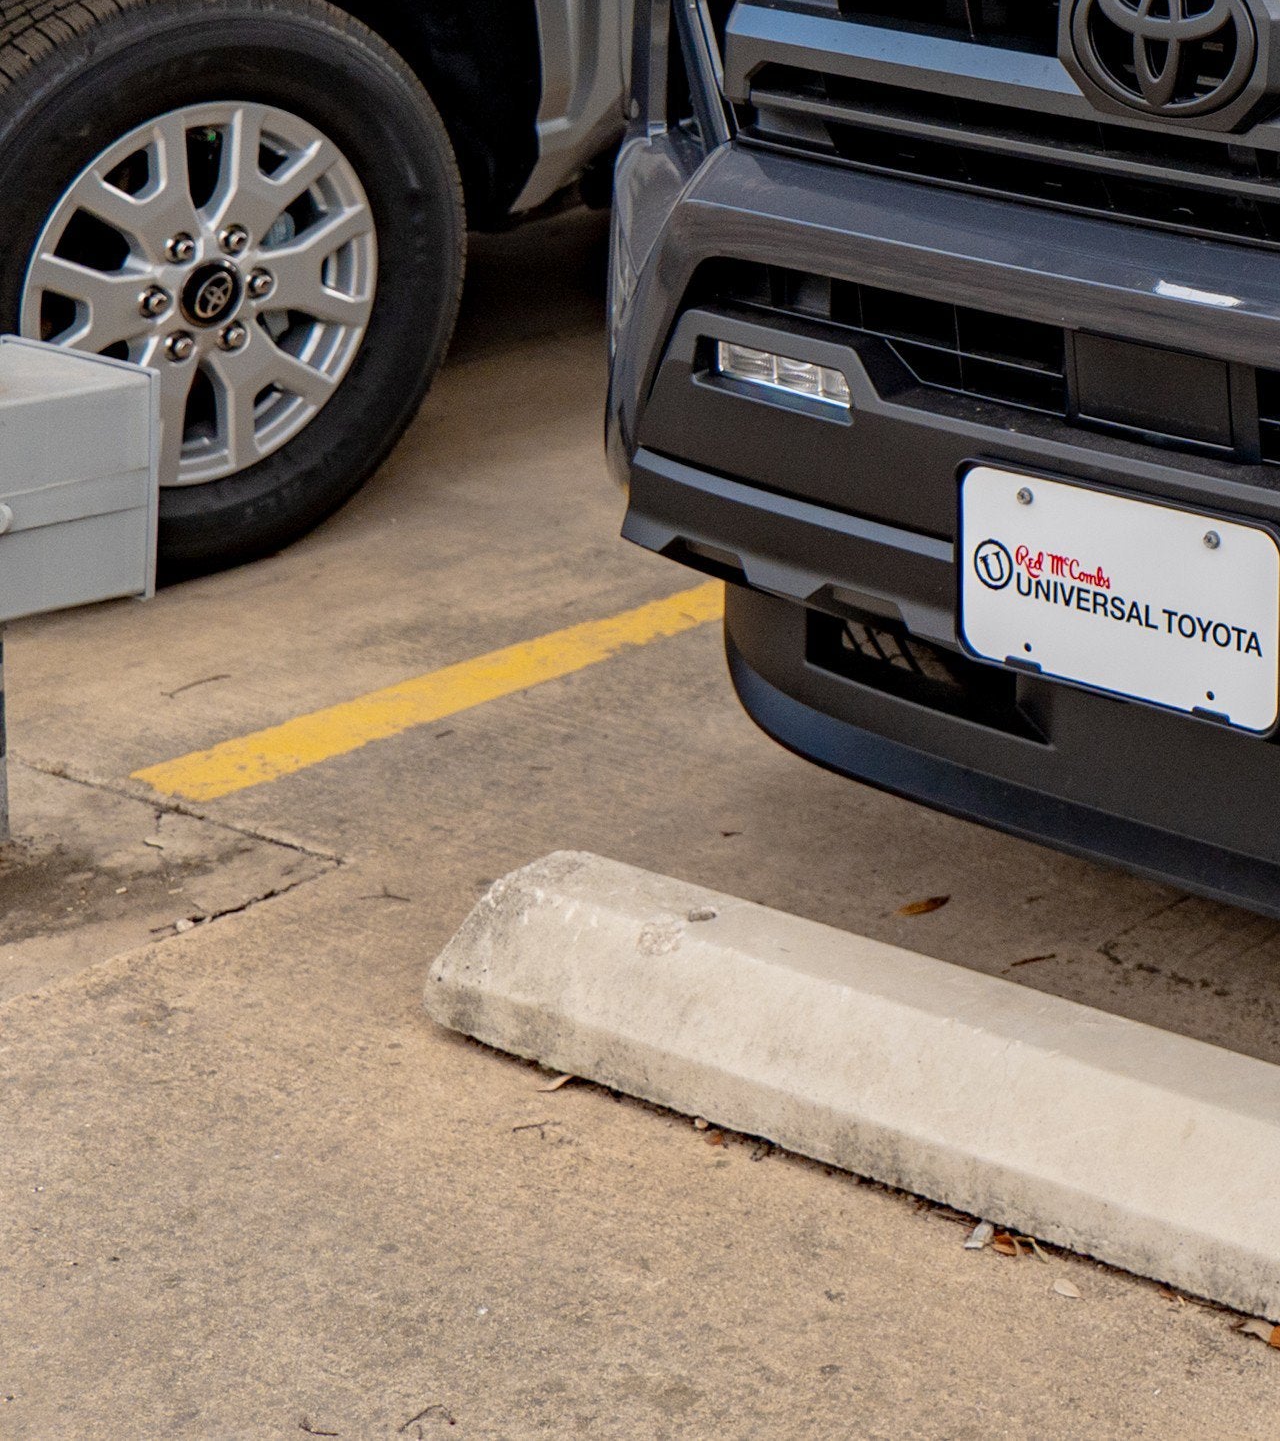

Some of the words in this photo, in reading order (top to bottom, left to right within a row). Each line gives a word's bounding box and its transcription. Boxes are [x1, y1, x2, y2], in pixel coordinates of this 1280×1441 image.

[1015, 545, 1044, 579] Red
[1016, 571, 1159, 631] UNIVERSAL
[1161, 608, 1263, 658] TOYOTA
